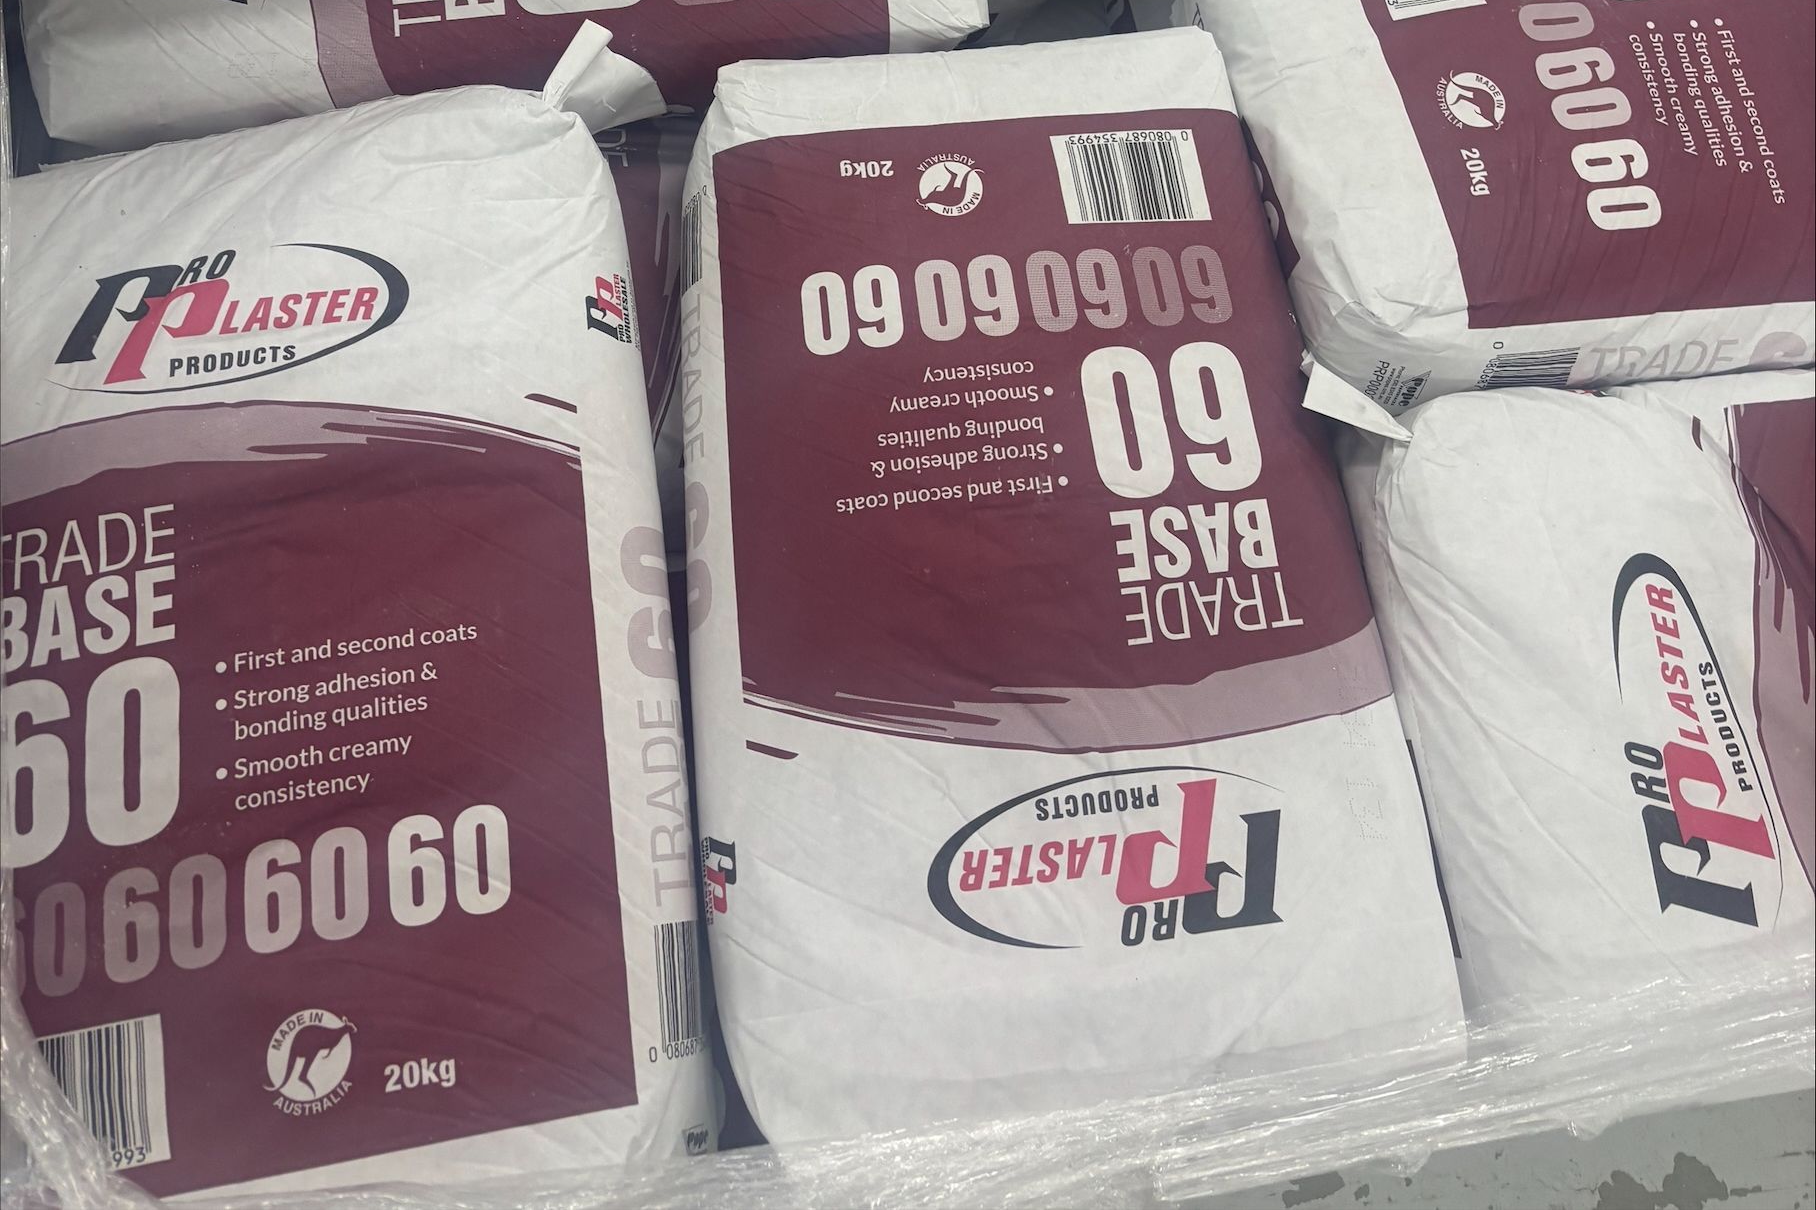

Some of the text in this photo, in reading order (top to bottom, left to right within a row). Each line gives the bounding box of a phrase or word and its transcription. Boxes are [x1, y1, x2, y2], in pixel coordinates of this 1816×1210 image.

[1435, 76, 1464, 130] AUSTRALIA
[1535, 47, 1633, 131] 60
[1629, 34, 1670, 128] consistency
[1648, 32, 1699, 157] Smooth creamy
[1673, 31, 1728, 168] bonding qualities
[1691, 30, 1754, 174] Strong adhesion &
[1068, 130, 1173, 147] 080687 354993
[1716, 29, 1786, 205] First and second coats
[840, 160, 894, 179] 20kg
[916, 153, 975, 173] AUSTRALIA
[1460, 147, 1491, 197] 20kg
[1570, 138, 1663, 231] 60
[800, 245, 1233, 357] 60 60 60 60
[103, 278, 380, 385] PLASTER
[169, 344, 297, 378] PRODUCTS
[923, 361, 1034, 384] consistency
[889, 384, 1039, 413] Smooth creamy
[1080, 341, 1263, 499] 60
[877, 416, 1044, 450] bonding qualities
[870, 442, 1049, 478] Strong adhesion &
[836, 476, 1054, 515] First and second coats
[1109, 498, 1280, 584] BASE
[1119, 572, 1305, 647] TRADE
[234, 622, 479, 673] First and second coats
[234, 660, 438, 711] Strong adhesion &
[234, 694, 429, 741] bonding qualities
[1645, 582, 1776, 860] PLASTER
[1698, 661, 1753, 793] PRODUCTS
[2, 656, 182, 869] 60
[233, 732, 413, 780] Smooth creamy
[234, 770, 371, 812] consistency
[636, 699, 690, 908] TRADE
[1035, 784, 1160, 822] PRODUCTS
[959, 777, 1218, 906] PLASTER
[103, 804, 511, 984] 60 60 60
[271, 1011, 325, 1052] MADE IN
[272, 1078, 353, 1117] AUSTRALIA
[383, 1058, 457, 1093] 20kg
